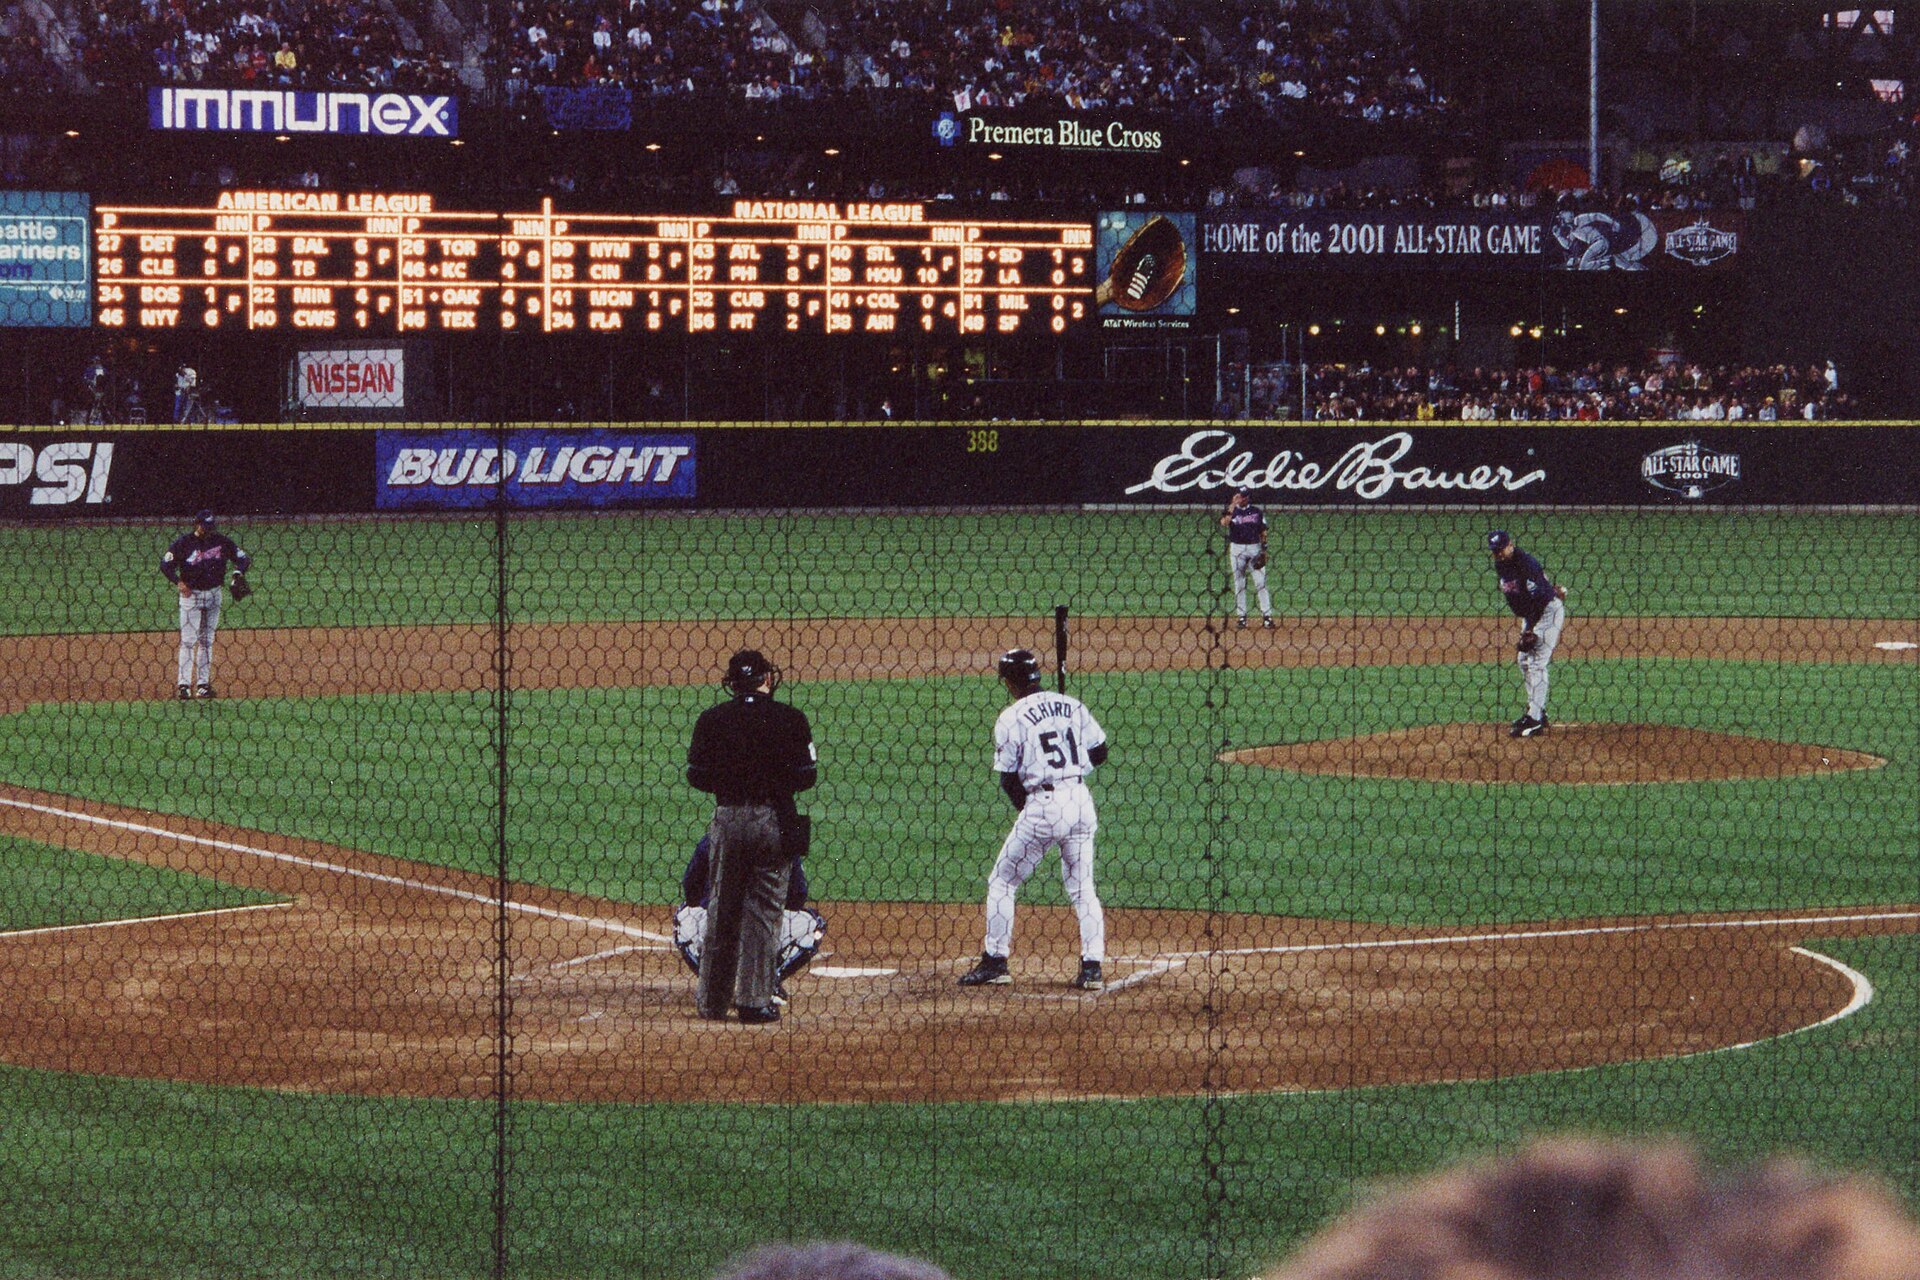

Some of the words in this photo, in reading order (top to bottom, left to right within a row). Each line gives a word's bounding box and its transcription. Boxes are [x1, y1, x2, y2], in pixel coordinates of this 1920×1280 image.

[969, 117, 1054, 146] Premera
[1058, 120, 1102, 147] Blue
[1107, 122, 1162, 149] Cross
[216, 192, 339, 212] AMERICAN
[346, 195, 432, 213] LEAGUE
[734, 202, 841, 220] NATIONAL
[847, 204, 924, 221] LEAGUE
[216, 217, 249, 231] INN
[366, 218, 399, 234] INN
[513, 221, 545, 237] INN
[658, 223, 689, 238] INN
[796, 225, 828, 240] INN
[931, 228, 962, 243] INN
[1062, 230, 1092, 244] INN
[1204, 223, 1260, 253] HOME
[1266, 223, 1288, 254] of
[1291, 223, 1322, 254] the
[1328, 223, 1385, 254] 2001
[1487, 224, 1542, 255] GAME
[140, 235, 175, 252] DET
[293, 237, 328, 254] BAL
[441, 238, 476, 256] TOR
[590, 242, 630, 258] NYM
[730, 244, 760, 259] ATL
[867, 245, 895, 261] STL
[999, 246, 1025, 263] SD
[140, 258, 174, 275] CLE
[292, 260, 315, 276] TB
[441, 262, 466, 278] KC
[590, 264, 620, 280] CIN
[730, 266, 757, 281] PHI
[867, 267, 902, 283] HOU
[999, 269, 1020, 284] LA
[141, 286, 180, 303] BOS
[293, 287, 330, 304] MIN
[442, 288, 480, 305] OAK
[590, 290, 632, 306] MON
[730, 291, 764, 307] CUB
[867, 293, 899, 309] COL
[999, 294, 1029, 309] MIL
[141, 309, 179, 326] NYY
[293, 310, 335, 326] CWS
[441, 311, 475, 328] TEX
[590, 312, 621, 328] FLA
[730, 313, 754, 329] PIT
[866, 314, 894, 330] ARI
[999, 315, 1019, 330] SF
[1103, 319, 1121, 328] AT&T
[1123, 319, 1156, 329] Wireless
[1158, 319, 1189, 329] Services
[307, 363, 395, 393] NISSAN
[966, 430, 998, 452] 388
[386, 448, 518, 486] BUD
[517, 445, 690, 484] LIGHT
[1125, 430, 1325, 495] Eddie
[1336, 432, 1546, 499] Bauer
[1702, 455, 1739, 477] GAME
[1024, 701, 1072, 726] ICHIRO
[1039, 726, 1080, 770] 51
